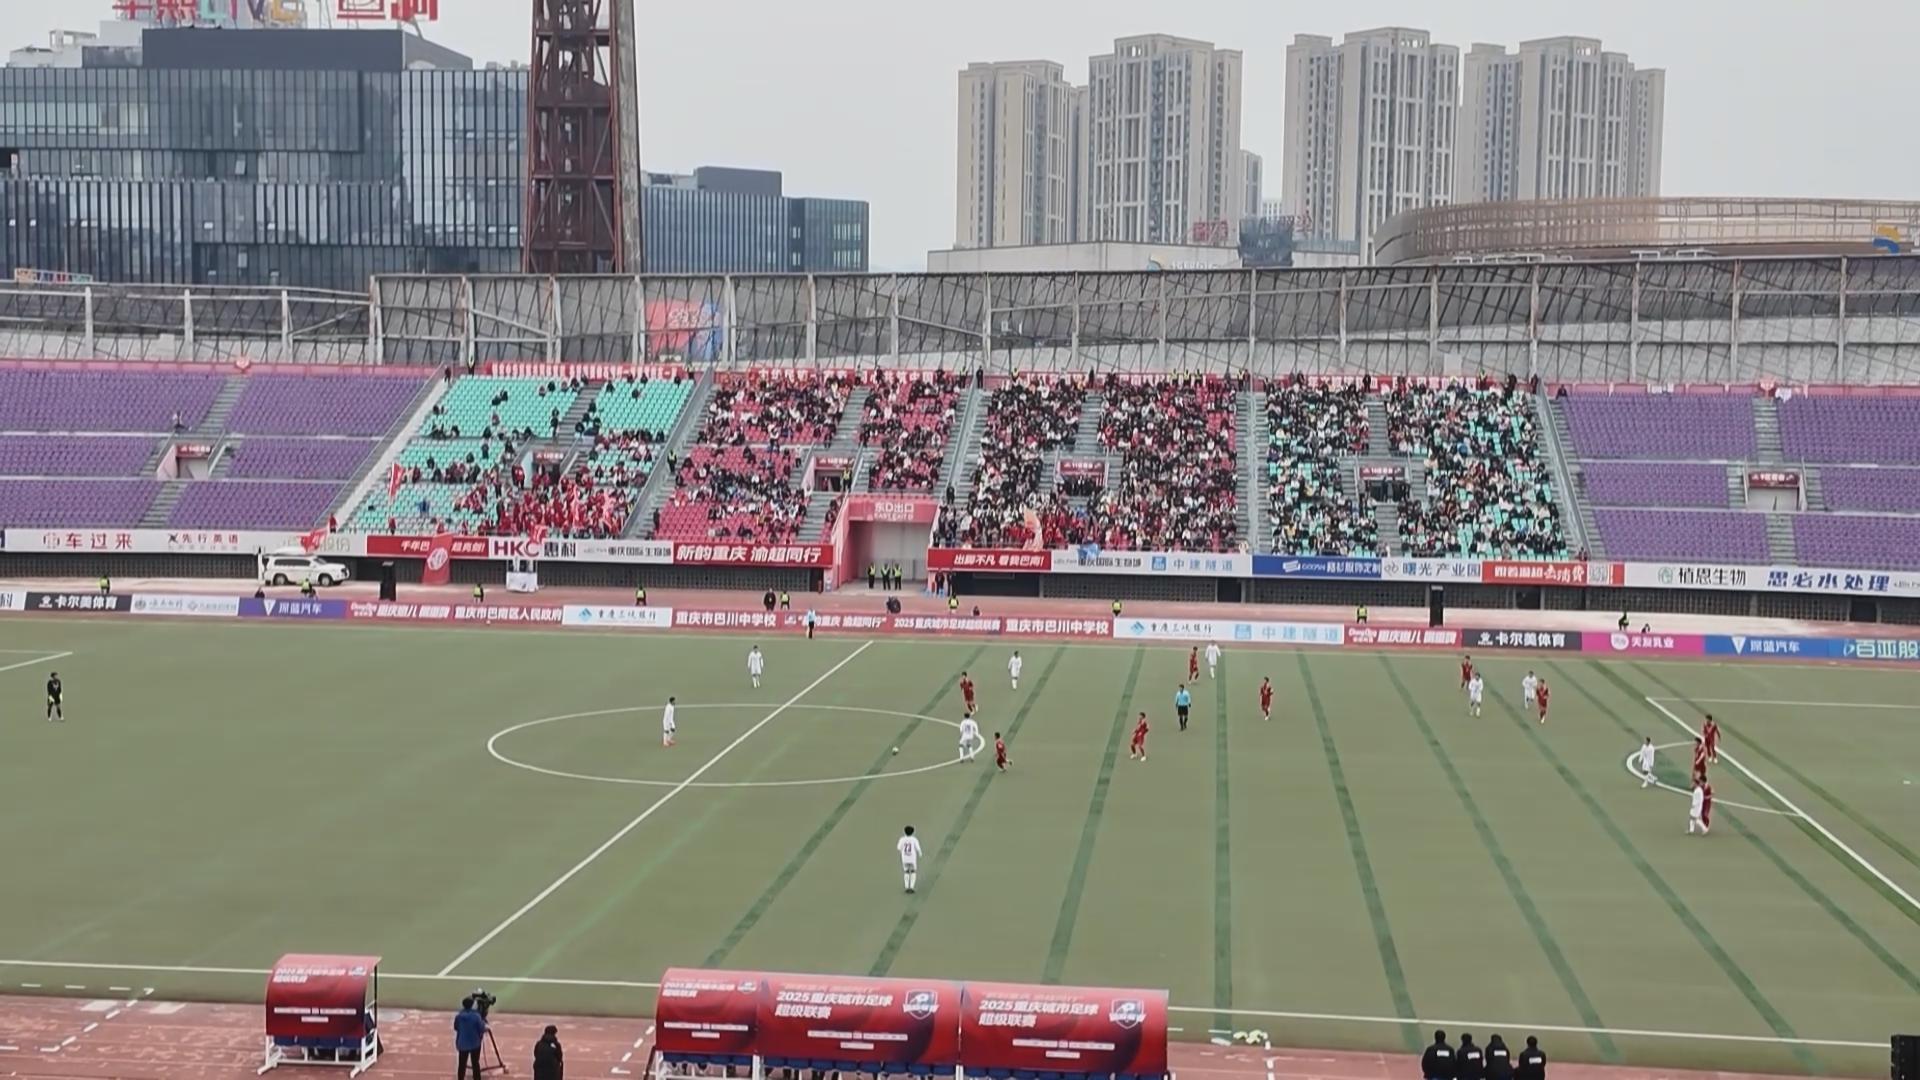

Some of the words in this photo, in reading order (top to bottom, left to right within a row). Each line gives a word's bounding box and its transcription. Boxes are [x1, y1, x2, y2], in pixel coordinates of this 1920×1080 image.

[401, 540, 431, 552] 千年巴
[451, 542, 486, 552] 超亮剑!
[494, 541, 540, 557] HKC
[544, 541, 576, 557] 惠科
[677, 546, 746, 562] 新的重庆
[751, 547, 822, 563] 渝超同行
[1174, 559, 1233, 571] 中建隧道
[1403, 559, 1480, 577] 曙光产业园
[1679, 567, 1746, 586] 植恩生物
[1767, 571, 1890, 592] 思必水处理
[54, 596, 117, 610] 卡尔美体育
[279, 602, 322, 615] 深蓝汽车
[455, 607, 562, 620] 重庆市巴南区人民政府
[676, 612, 776, 627] 重庆市巴川中学校
[1005, 620, 1109, 635] 重庆市巴川中学校
[1262, 626, 1340, 641] 中建隧道
[1495, 632, 1565, 647] 卡尔美体育
[1750, 639, 1800, 653] 深蓝汽车
[775, 1004, 832, 1019] 超级联赛
[978, 1013, 1037, 1028] 超级联赛
